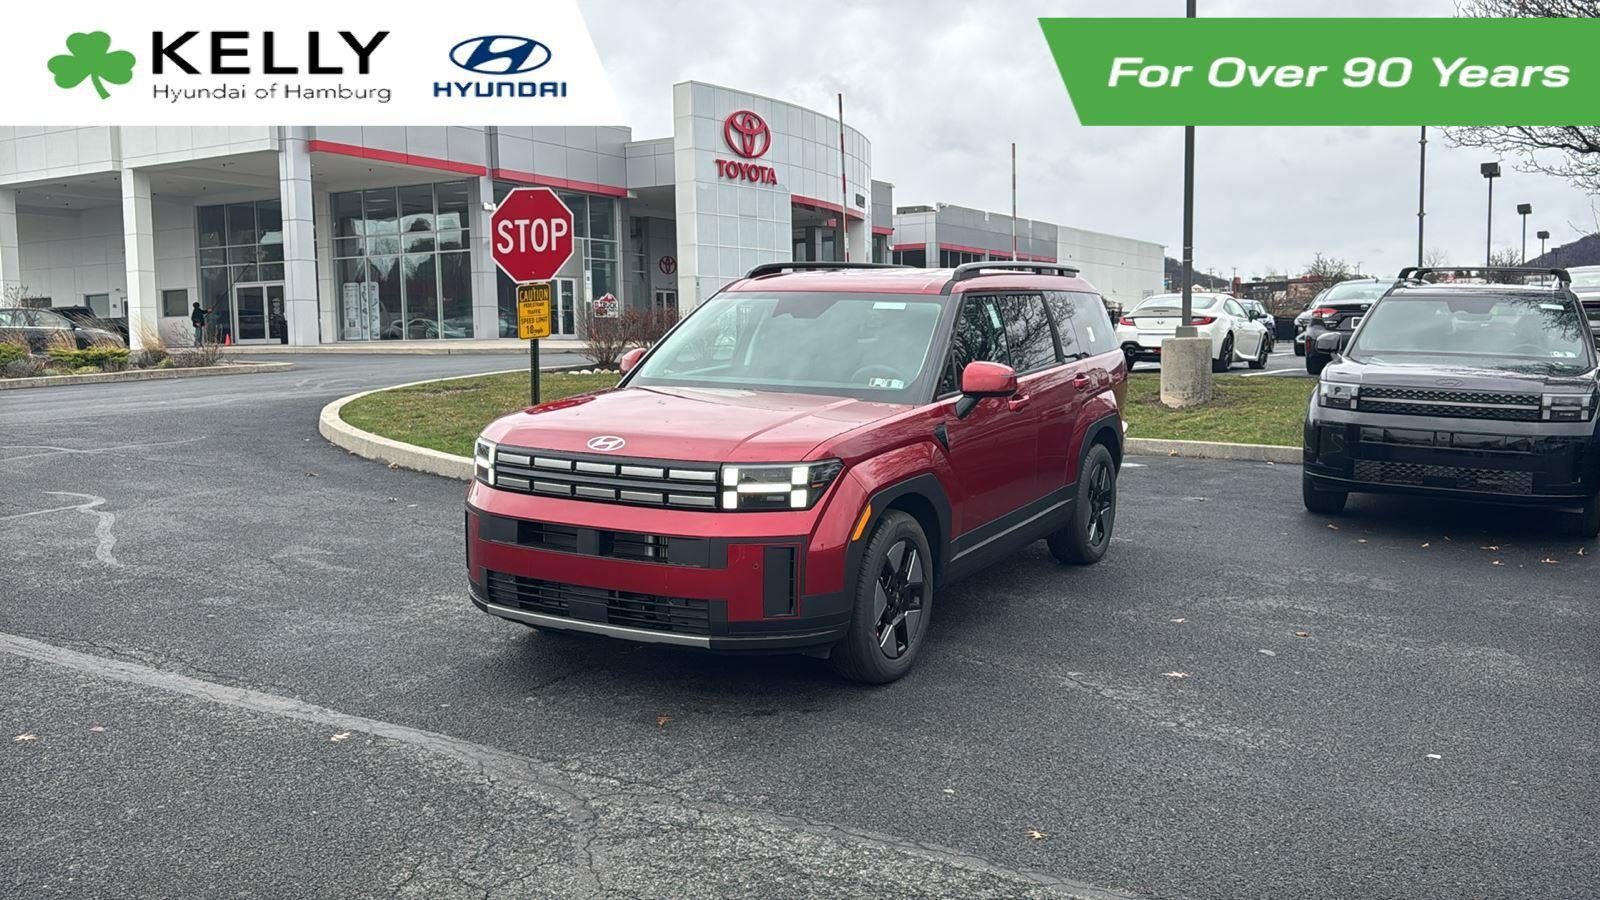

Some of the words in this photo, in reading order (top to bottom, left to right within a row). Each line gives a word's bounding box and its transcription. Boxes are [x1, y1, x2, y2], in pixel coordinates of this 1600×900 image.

[715, 159, 778, 185] TOYOTA
[497, 218, 568, 254] STOP
[520, 288, 549, 302] CAUTION
